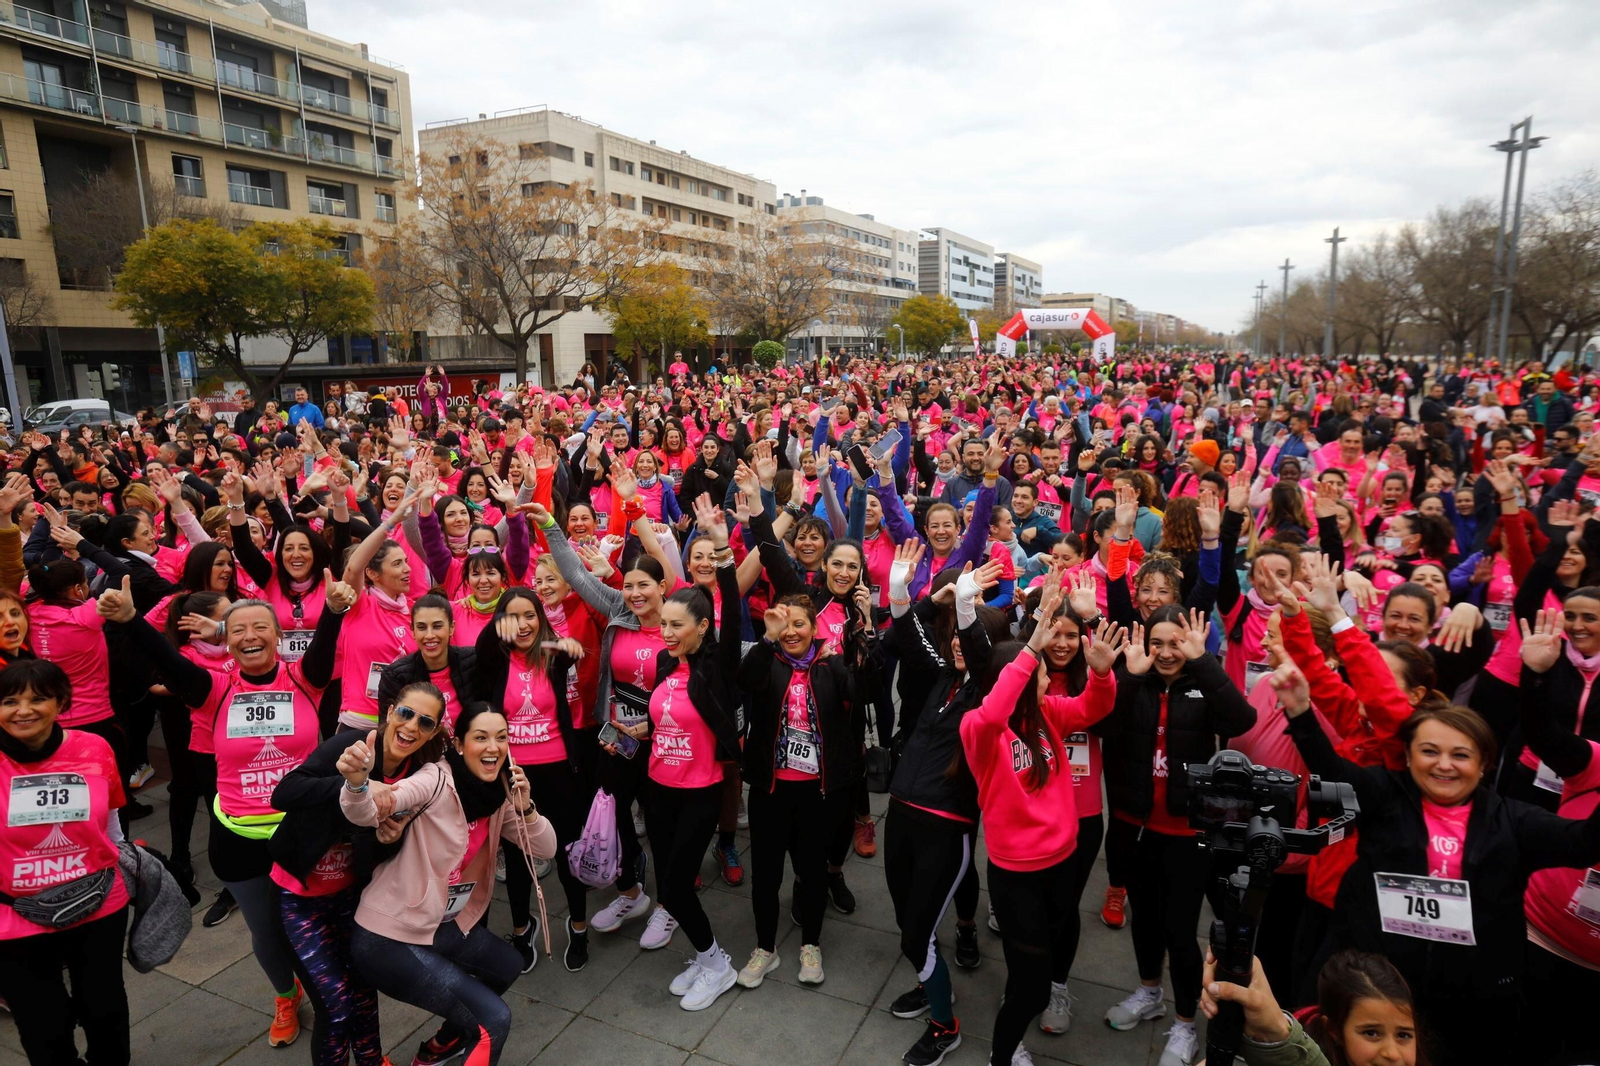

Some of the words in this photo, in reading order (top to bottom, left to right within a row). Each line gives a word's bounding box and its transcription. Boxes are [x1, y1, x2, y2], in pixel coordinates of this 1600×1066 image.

[1029, 312, 1070, 324] cajasur
[289, 640, 308, 652] 813
[245, 705, 276, 722] 396
[508, 722, 550, 737] PINK
[656, 733, 692, 750] PINK
[261, 756, 295, 767] EDICIÓN
[663, 758, 680, 766] 2023
[36, 788, 70, 807] 313
[13, 852, 88, 879] PINK
[12, 867, 88, 888] RUNNING
[1403, 894, 1441, 920] 749
